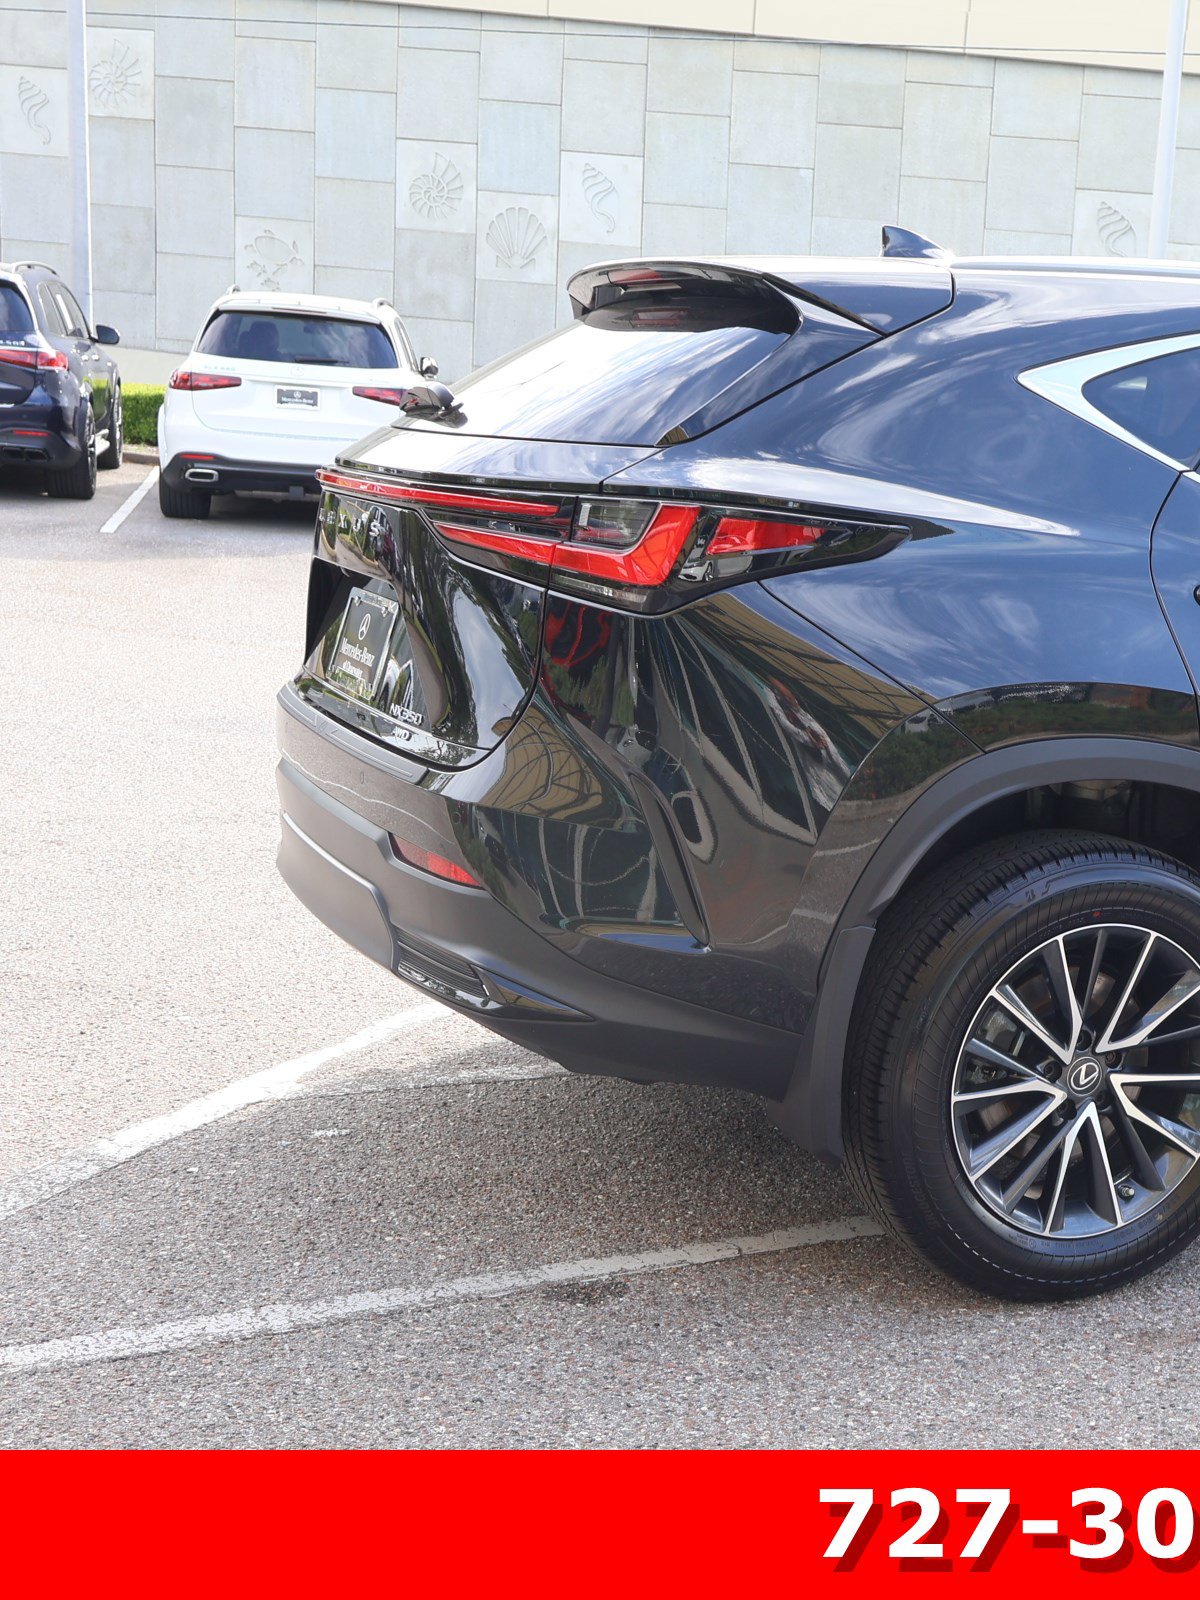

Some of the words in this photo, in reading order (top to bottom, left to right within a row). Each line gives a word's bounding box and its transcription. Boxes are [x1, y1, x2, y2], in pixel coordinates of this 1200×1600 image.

[318, 507, 381, 537] LEXUS
[339, 637, 375, 668] Mercedes-Benz
[390, 725, 411, 740] AWD
